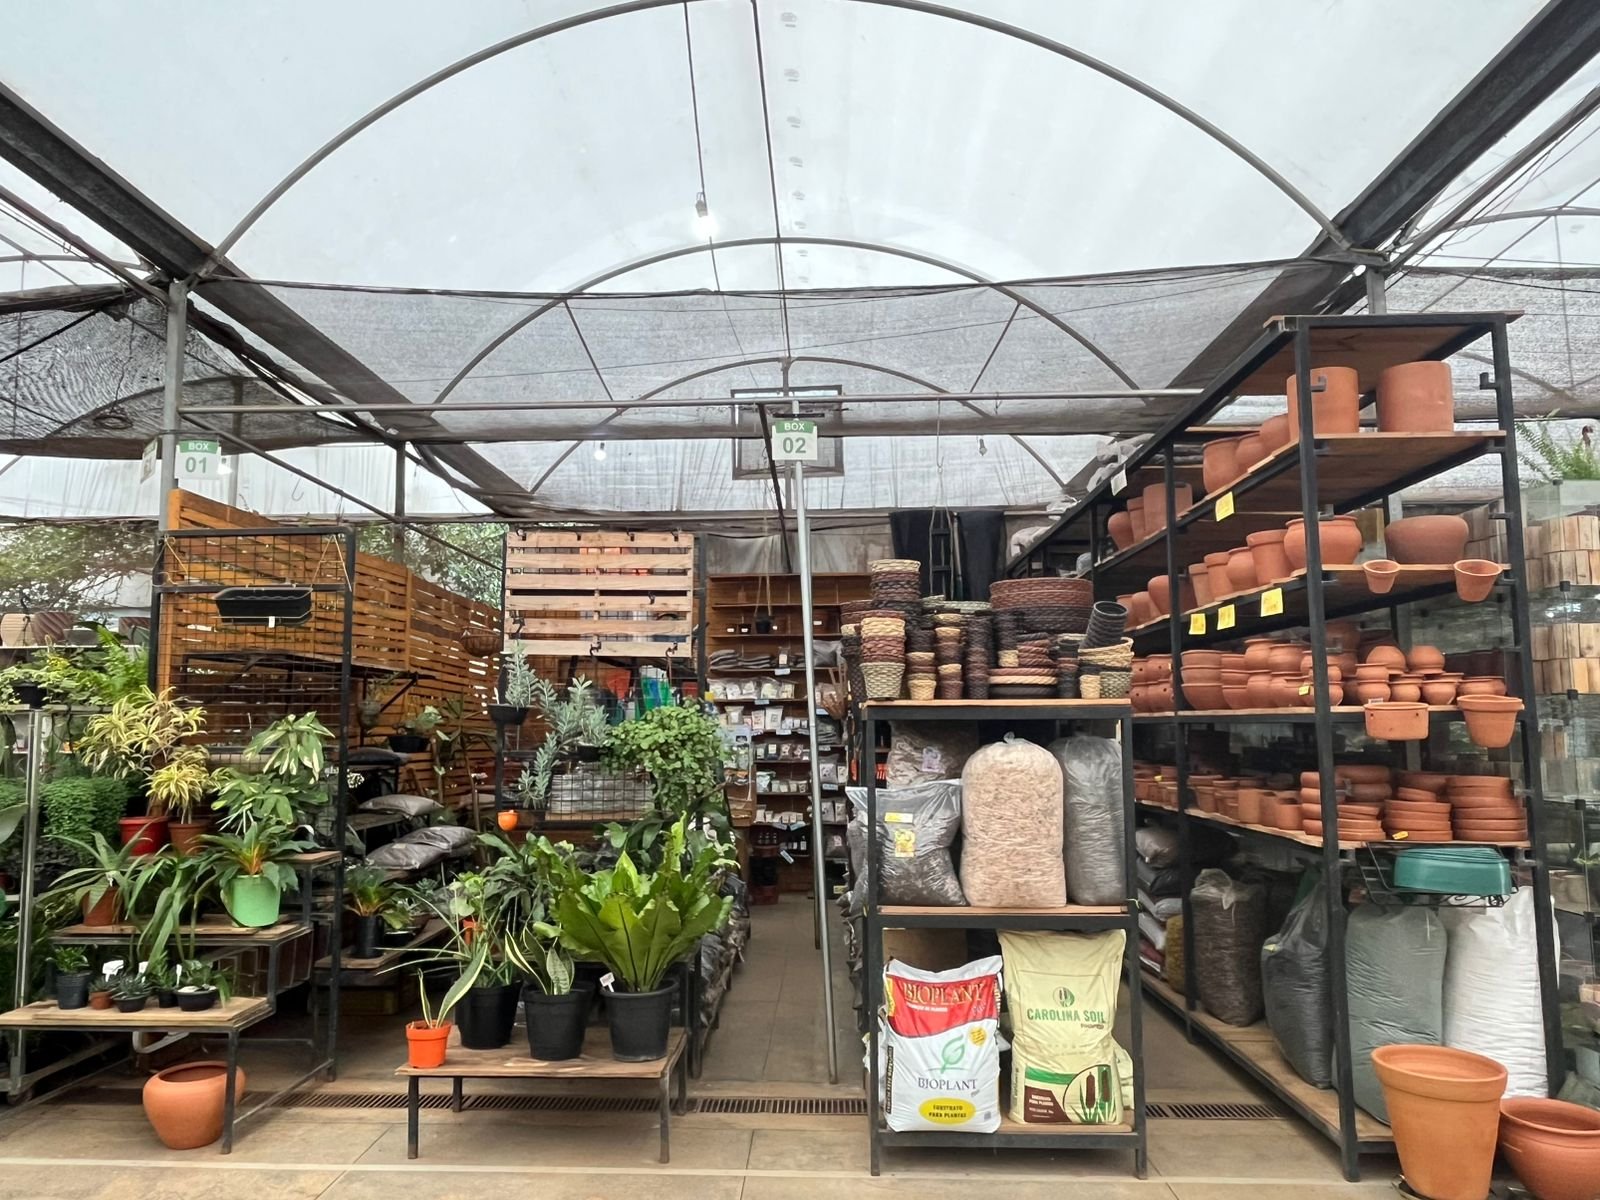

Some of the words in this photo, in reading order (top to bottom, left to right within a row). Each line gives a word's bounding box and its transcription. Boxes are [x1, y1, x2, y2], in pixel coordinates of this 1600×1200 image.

[784, 422, 805, 431] BOX
[188, 442, 209, 451] BOX
[782, 437, 807, 454] 02
[185, 456, 207, 474] 01
[903, 982, 985, 1006] BIOPLANT
[1026, 1008, 1081, 1022] CAROLINA
[1083, 1010, 1106, 1024] SOIL
[917, 1077, 978, 1091] BIOPLANT
